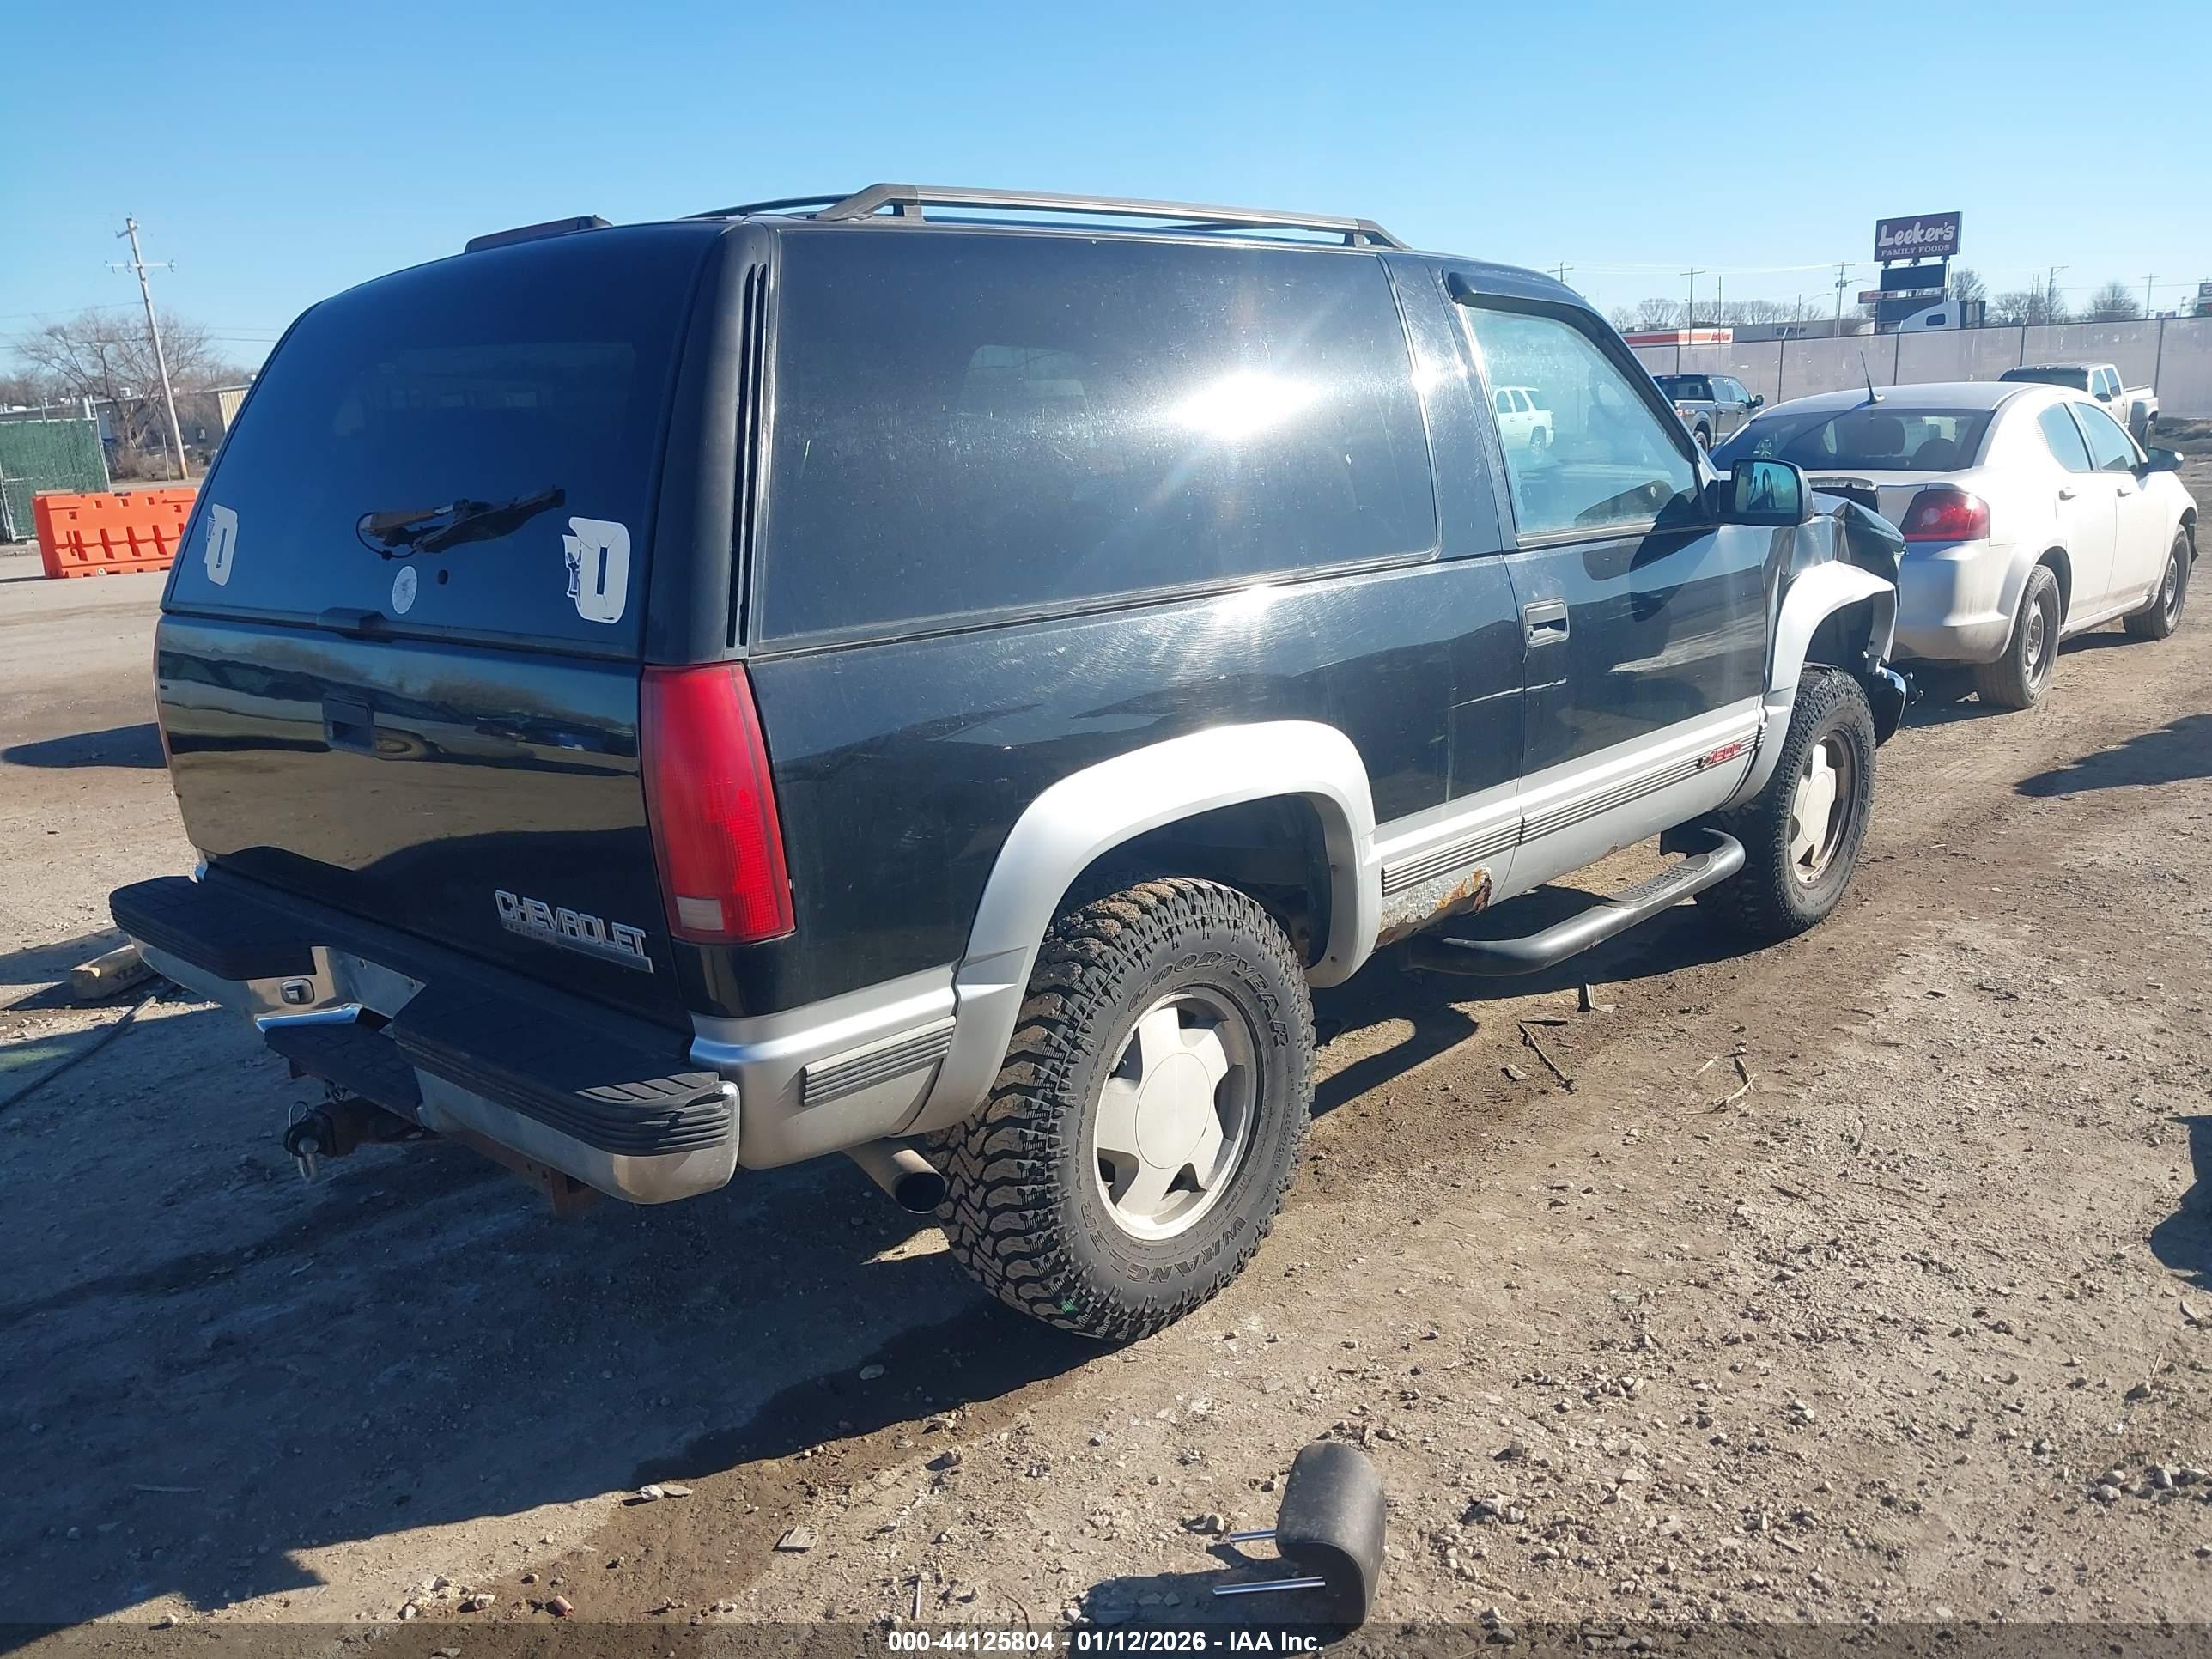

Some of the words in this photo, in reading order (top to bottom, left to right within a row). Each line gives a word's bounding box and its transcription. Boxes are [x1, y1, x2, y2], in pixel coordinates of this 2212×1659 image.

[1878, 221, 1956, 247] Leeker's
[1881, 246, 1917, 257] FAMILY
[1918, 244, 1951, 254] FOODS
[494, 889, 647, 957] CHEVROLET
[1127, 950, 1290, 1048] GOODYEAR
[1080, 1200, 1249, 1284] WRANGLER
